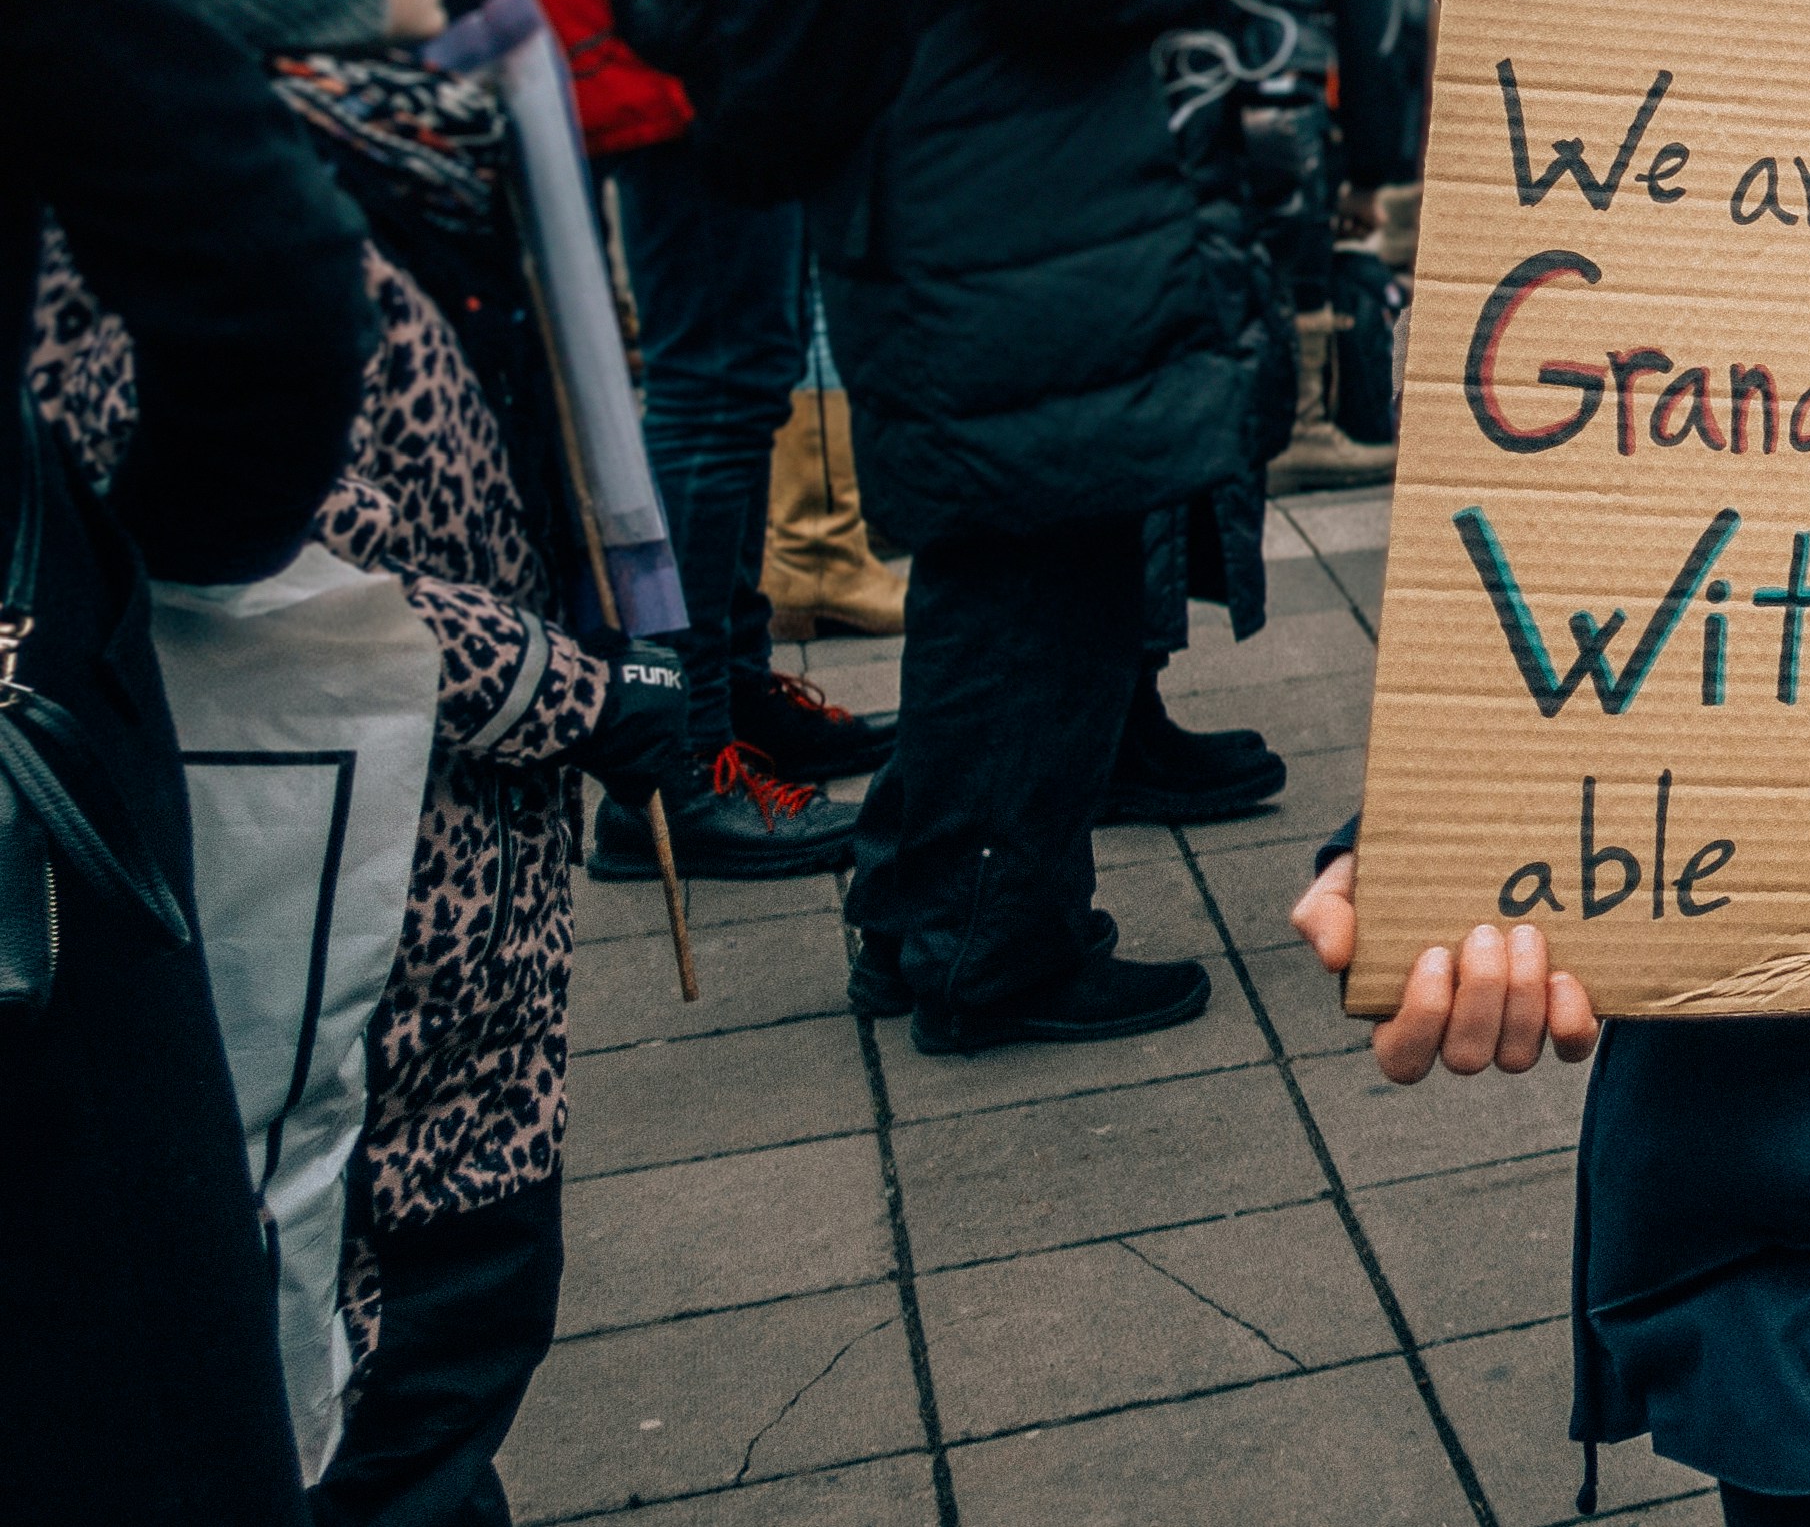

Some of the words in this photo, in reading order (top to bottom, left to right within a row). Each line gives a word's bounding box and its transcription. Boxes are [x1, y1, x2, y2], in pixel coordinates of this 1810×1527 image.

[1495, 59, 1689, 211] We
[621, 664, 683, 690] FUNK
[1498, 769, 1736, 920] able
